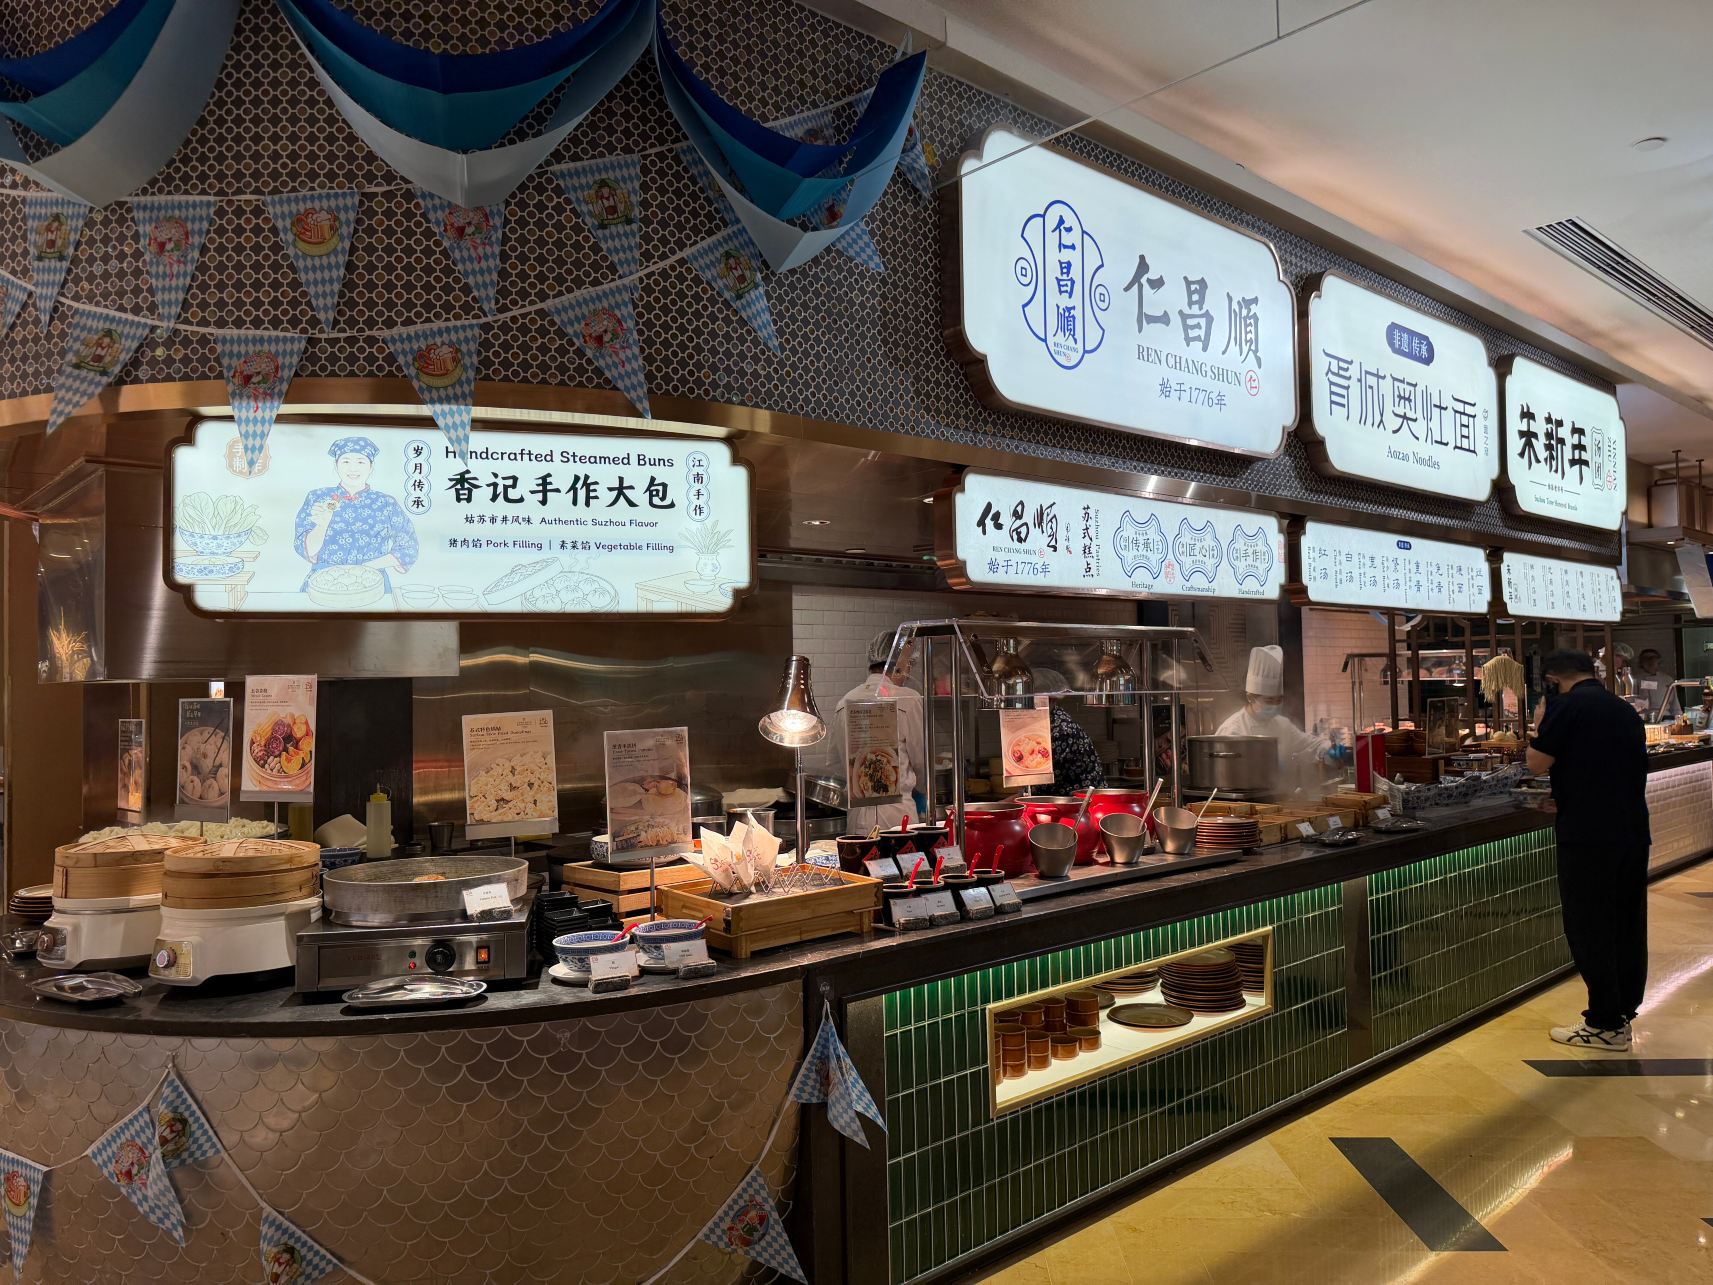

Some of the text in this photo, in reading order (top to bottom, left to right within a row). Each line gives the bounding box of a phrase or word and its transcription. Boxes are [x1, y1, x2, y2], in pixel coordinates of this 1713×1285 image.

[1051, 214, 1078, 345] 仁昌順
[1122, 254, 1262, 370] 仁昌順
[1136, 343, 1242, 387] REN CHANG SHUN
[1158, 377, 1227, 412] 始于1776年
[1322, 348, 1478, 457] 胥城奥灶面
[1517, 401, 1591, 486] 朱新年
[445, 446, 675, 468] Hndcrafted Steamed Buns
[1386, 444, 1441, 470] Aozao Noodles
[410, 444, 426, 509] 岁月传承
[690, 457, 705, 517] 江南手作
[444, 469, 676, 510] 香记手作大包
[464, 514, 534, 526] 姑苏市井风味
[540, 516, 659, 529] Authentic Suzhou Flavor
[448, 537, 483, 550] 猪肉馅
[486, 540, 543, 551] Pork Filling
[558, 540, 591, 551] 素菜馅
[594, 541, 675, 554] Vegetable Filling
[1082, 503, 1094, 579] 苏式糕点
[986, 557, 1051, 579] 始于1776年
[1131, 580, 1154, 590] Heritage
[1181, 584, 1216, 595] Craftsmanship
[1237, 588, 1265, 596] Handcrafted
